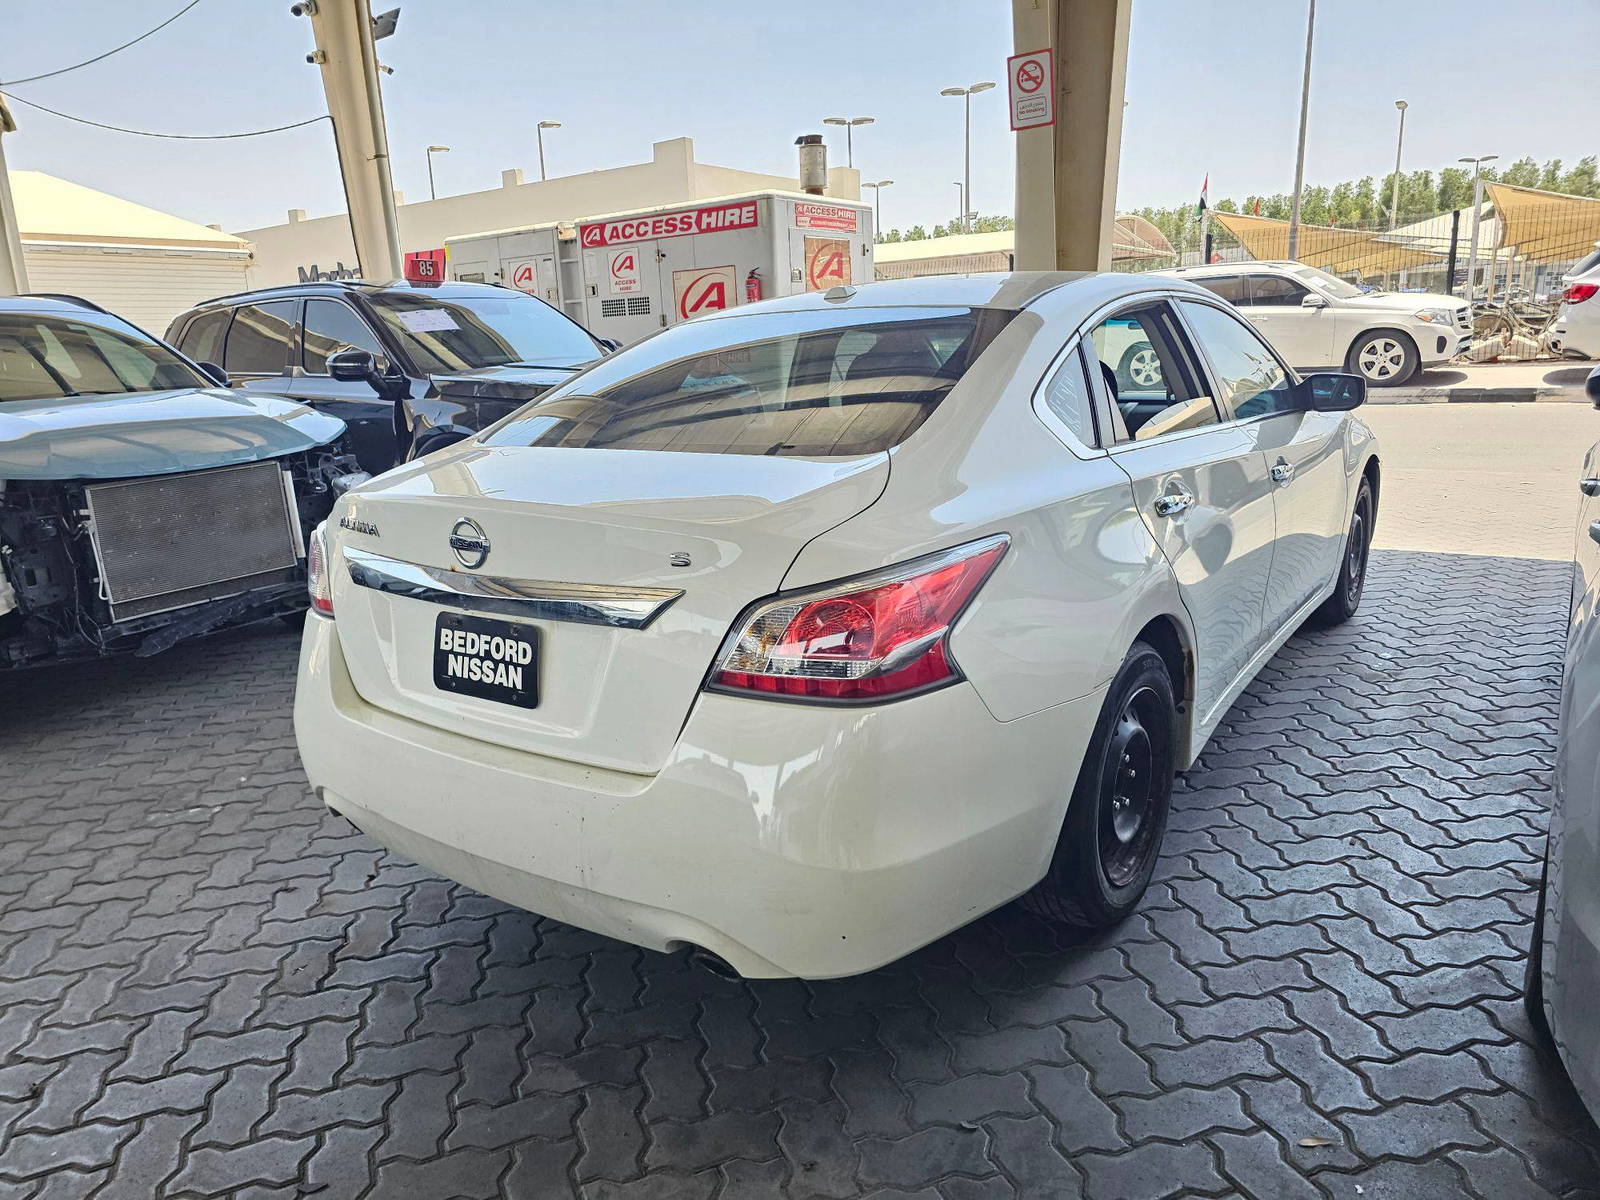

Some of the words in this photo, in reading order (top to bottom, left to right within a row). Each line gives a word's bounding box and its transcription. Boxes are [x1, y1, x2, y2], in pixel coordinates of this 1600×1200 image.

[805, 206, 837, 217] ACCESS
[608, 215, 694, 241] ACCESS
[700, 206, 756, 229] HIRE
[419, 261, 434, 276] 85
[340, 517, 381, 538] ALTIMA
[450, 536, 484, 550] NISSAN
[670, 552, 691, 567] S
[440, 628, 533, 665] BEDFORD
[448, 653, 523, 690] NISSAN
